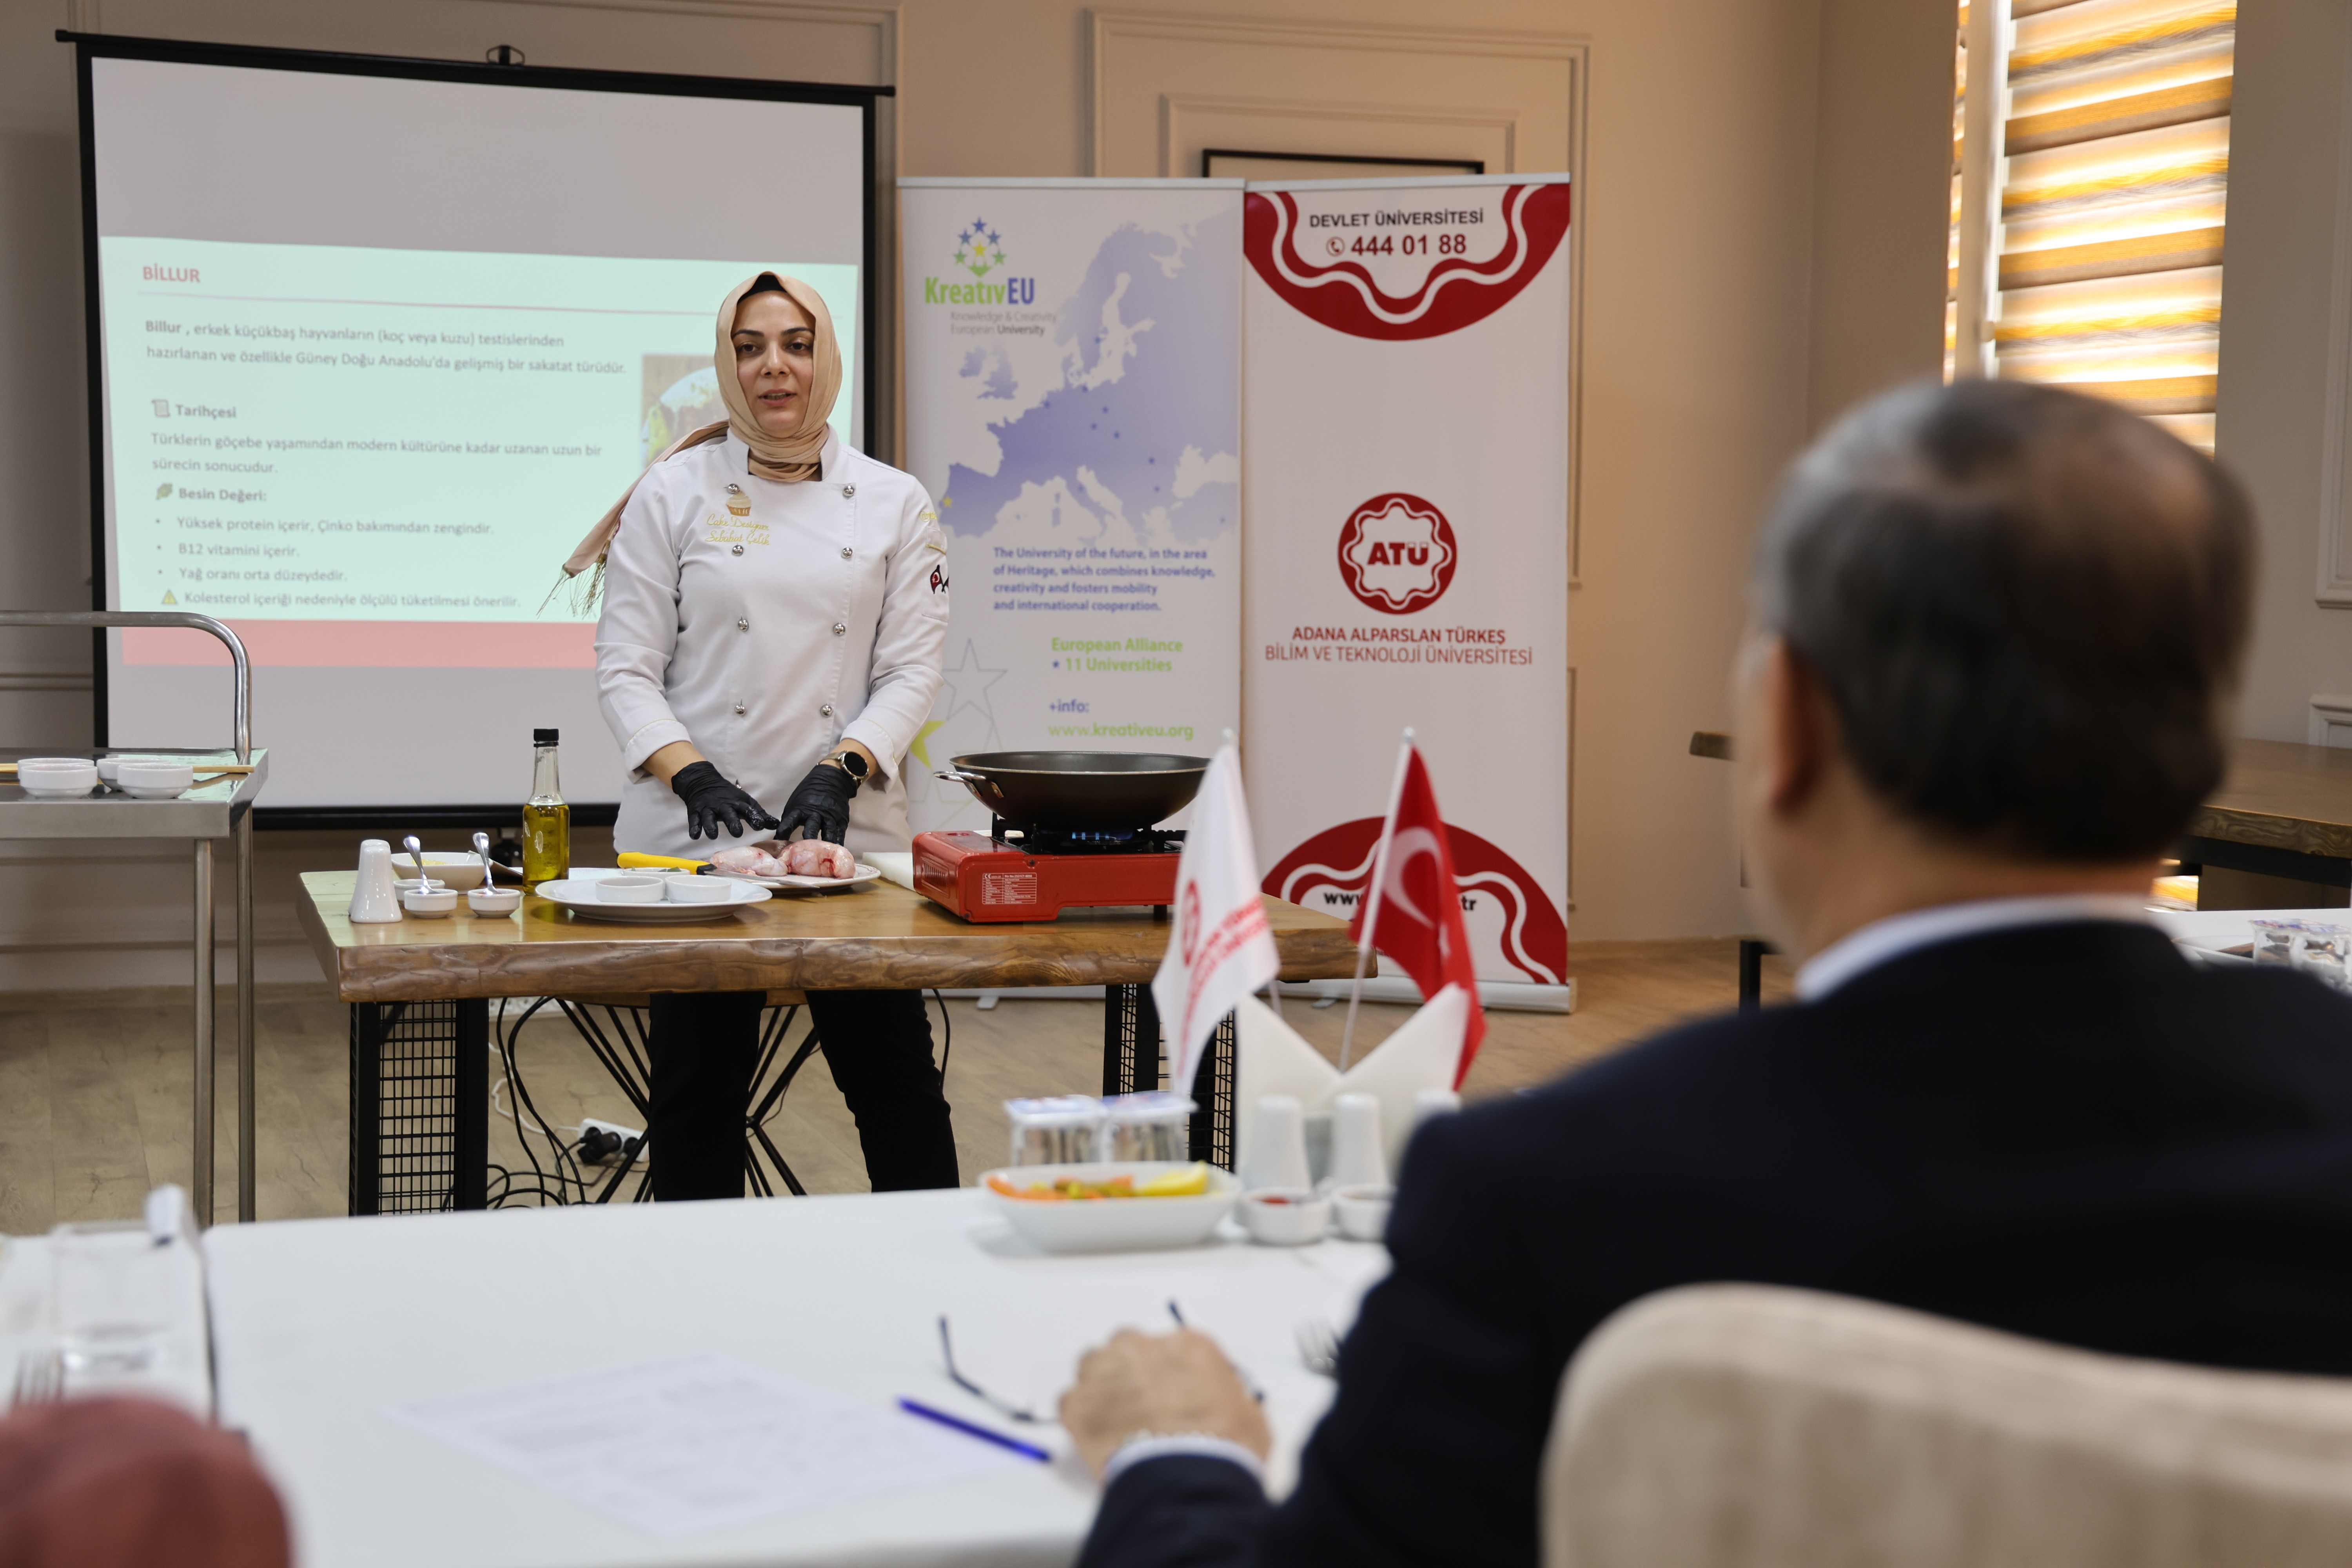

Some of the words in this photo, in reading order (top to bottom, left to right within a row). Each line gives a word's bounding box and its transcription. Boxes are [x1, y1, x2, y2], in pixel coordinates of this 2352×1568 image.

[1310, 213, 1370, 228] DEVLET
[1375, 208, 1483, 226] ÜNİVERSİTESİ
[1351, 236, 1394, 256] 444
[1402, 235, 1426, 255] 01
[1439, 234, 1466, 254] 88
[143, 263, 200, 283] BİLLUR
[950, 312, 1003, 323] Knowledge
[1014, 312, 1057, 324] Creativity
[194, 323, 230, 336] erkek
[234, 325, 296, 341] küçükbaş
[299, 327, 374, 341] hayvanların
[378, 330, 404, 345] (koç
[408, 334, 437, 345] veya
[441, 332, 475, 346] kuzu)
[478, 334, 564, 347] testislerinden
[951, 323, 995, 336] European
[997, 325, 1045, 337] University
[147, 346, 217, 361] hazırlanan
[221, 352, 236, 362] ve
[240, 351, 292, 363] özellikle
[296, 352, 338, 367] Güney
[341, 353, 375, 368] Doğu
[454, 358, 504, 372] gelişmiş
[508, 358, 524, 370] bir
[528, 359, 572, 372] sakatat
[576, 361, 625, 374] türüdür.
[176, 404, 236, 420] Tarihçesi
[151, 433, 211, 446] Türklerin
[215, 436, 262, 450] göçebe
[266, 438, 343, 451] yaşamından
[347, 439, 397, 451] modern
[401, 440, 462, 453] kültürüne
[466, 442, 500, 454] kadar
[505, 445, 549, 455] uzanan
[552, 446, 582, 456] uzun
[585, 445, 601, 456] bir
[152, 458, 201, 470] sürecin
[205, 461, 278, 473] sonucudur.
[179, 488, 215, 499] Besin
[219, 489, 266, 503] Değeri:
[177, 517, 223, 529] Yüksek
[227, 520, 274, 532] protein
[278, 520, 314, 533] içerir,
[318, 520, 353, 534] Çinko
[356, 521, 430, 533] bakımından
[434, 523, 494, 536] zengindir.
[707, 513, 729, 526] Cake
[731, 516, 769, 533] Designer
[705, 530, 744, 542] Sebahat
[179, 543, 203, 555] B12
[207, 544, 260, 555] vitamini
[263, 546, 299, 559] içerir.
[994, 547, 1014, 558] The
[1016, 548, 1073, 561] University
[1075, 547, 1087, 558] of
[1089, 547, 1107, 559] the
[1109, 548, 1146, 559] future,
[1149, 549, 1160, 559] in
[1162, 548, 1180, 559] the
[1183, 550, 1207, 559] area
[1367, 542, 1428, 566] ATÜ
[179, 568, 203, 581] Yağ
[206, 570, 240, 580] oranı
[243, 570, 270, 581] orta
[274, 570, 347, 583] düzeydedir.
[993, 564, 1005, 575] of
[1007, 565, 1058, 578] Heritage,
[1061, 565, 1093, 576] which
[1095, 566, 1149, 576] combines
[1151, 566, 1215, 579] knowledge,
[993, 583, 1045, 595] creativity
[1048, 583, 1069, 593] and
[1071, 582, 1109, 593] fosters
[1111, 583, 1158, 596] mobility
[185, 592, 250, 604] Kolesterol
[254, 593, 292, 607] içeriği
[295, 594, 356, 607] nedeniyle
[359, 594, 397, 608] ölçülü
[401, 595, 470, 606] tüketilmesi
[473, 596, 520, 607] önerilir.
[993, 599, 1014, 610] and
[1017, 600, 1089, 610] international
[1091, 601, 1161, 613] cooperation.
[1292, 626, 1347, 641] ADANA
[1350, 628, 1441, 642] ALPARSLAN
[1446, 627, 1505, 645] TÜRKEŞ
[1051, 637, 1121, 655] European
[1125, 638, 1183, 652] Alliance
[1265, 643, 1308, 661] BİLİM
[1313, 646, 1331, 661] VE
[1336, 645, 1421, 663] TEKNOLOJİ
[1426, 644, 1532, 665] ÜNİVERSİTESİ
[1066, 657, 1081, 671] 11
[1086, 657, 1172, 671] Universities
[1049, 699, 1089, 713] +info:
[1048, 722, 1194, 741] www.kreativeu.org
